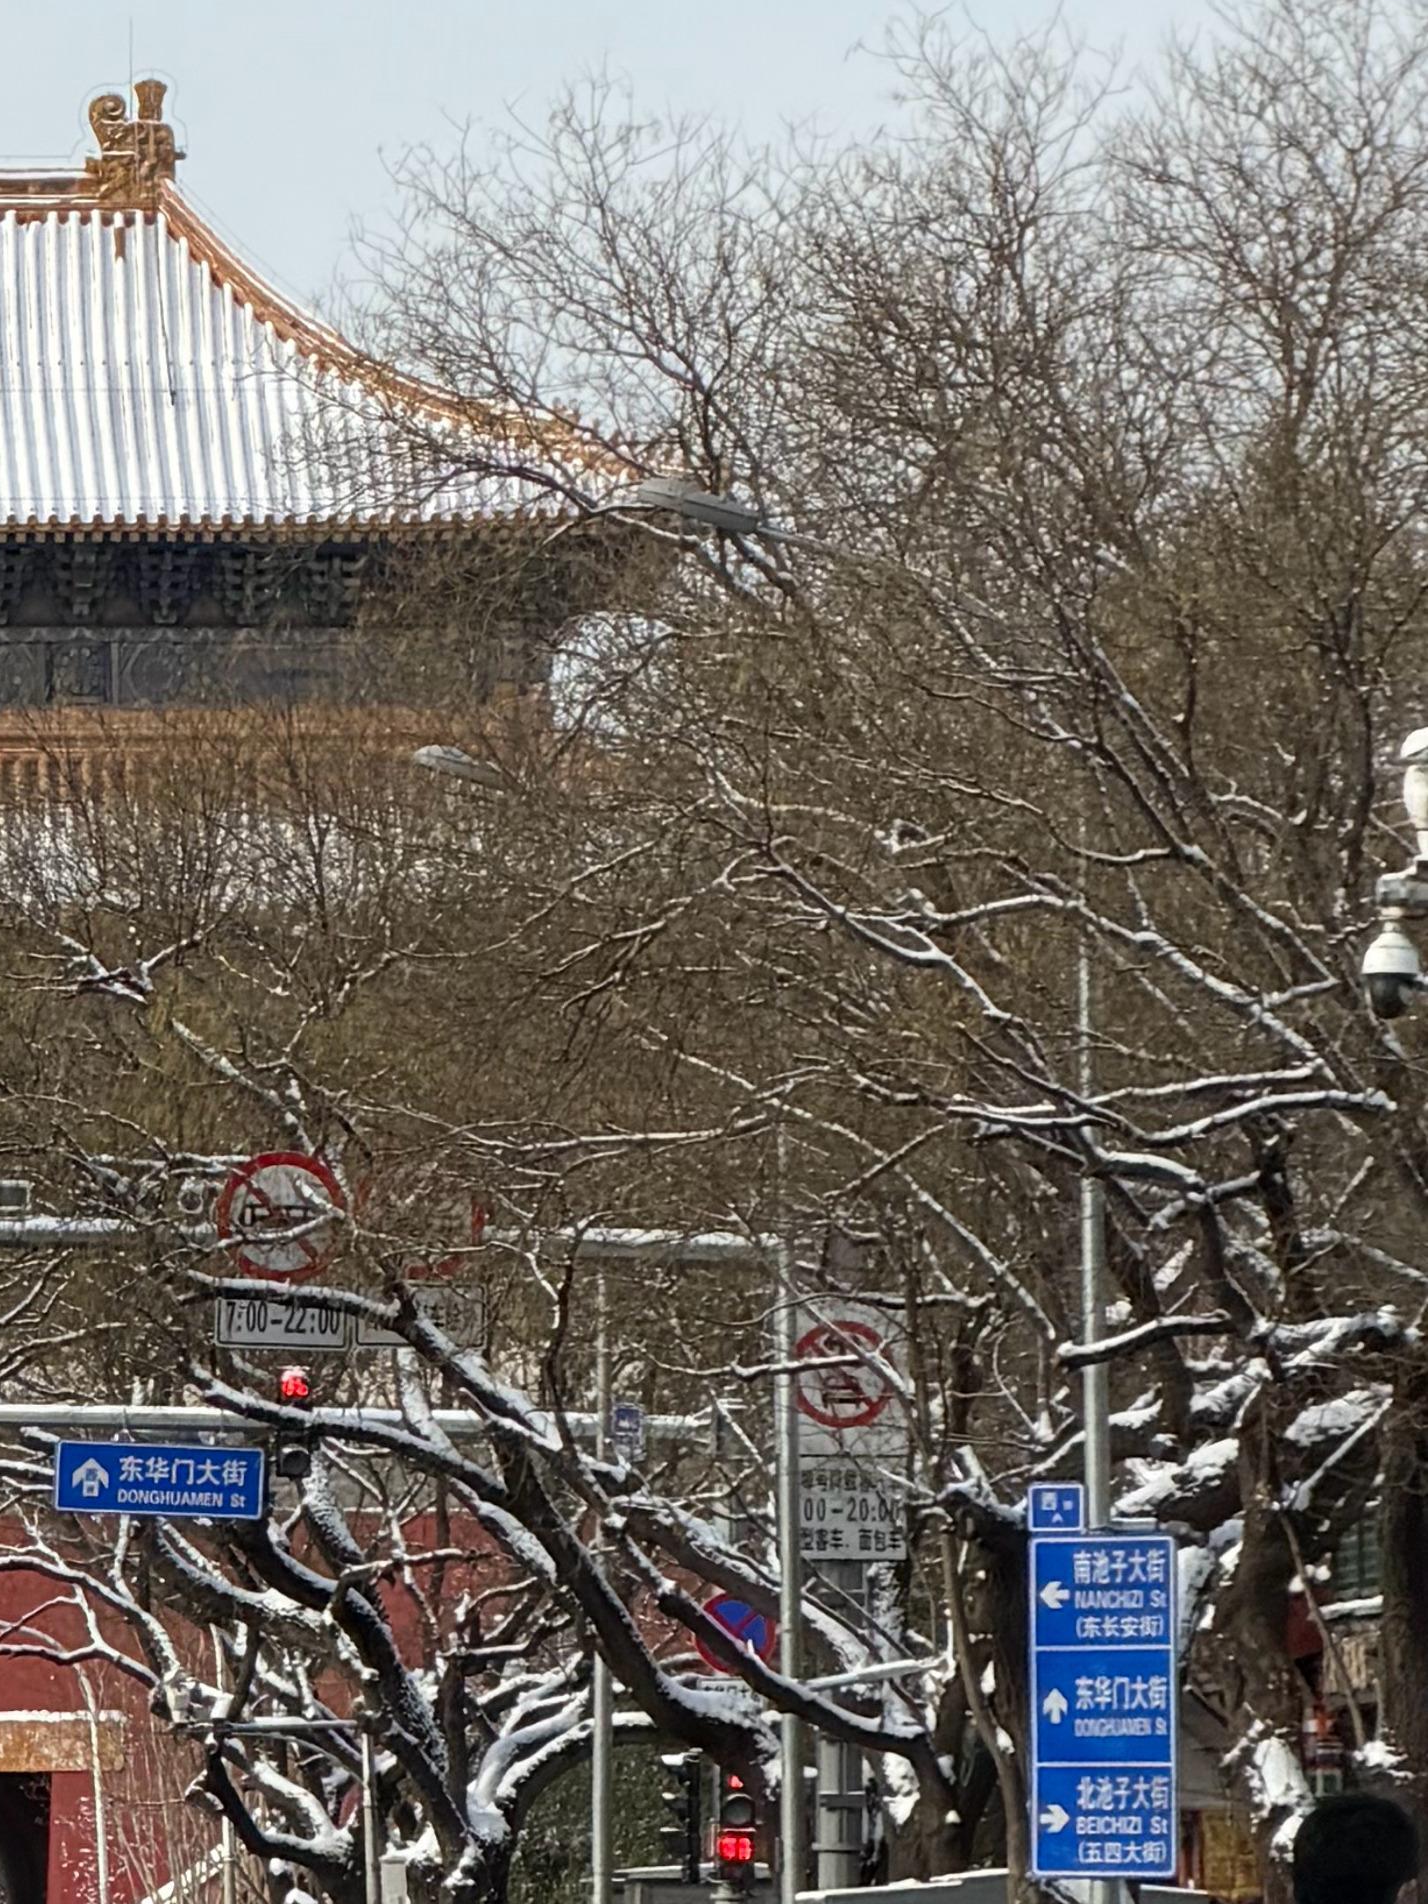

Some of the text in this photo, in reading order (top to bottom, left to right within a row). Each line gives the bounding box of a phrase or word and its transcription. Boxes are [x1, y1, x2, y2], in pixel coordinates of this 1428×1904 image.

[119, 1455, 248, 1487] 东华门大街
[117, 1488, 246, 1508] DONGHUAMEN St
[1073, 1549, 1166, 1584] 南池子大街
[1075, 1590, 1168, 1609] NANCHIZI St
[1076, 1616, 1164, 1638] (东长安街)
[1075, 1675, 1168, 1710] 东华门大街
[1076, 1775, 1169, 1811] 北池子大街
[1075, 1816, 1169, 1835] BEICHIZI St
[1078, 1841, 1167, 1864] (五四大街)
